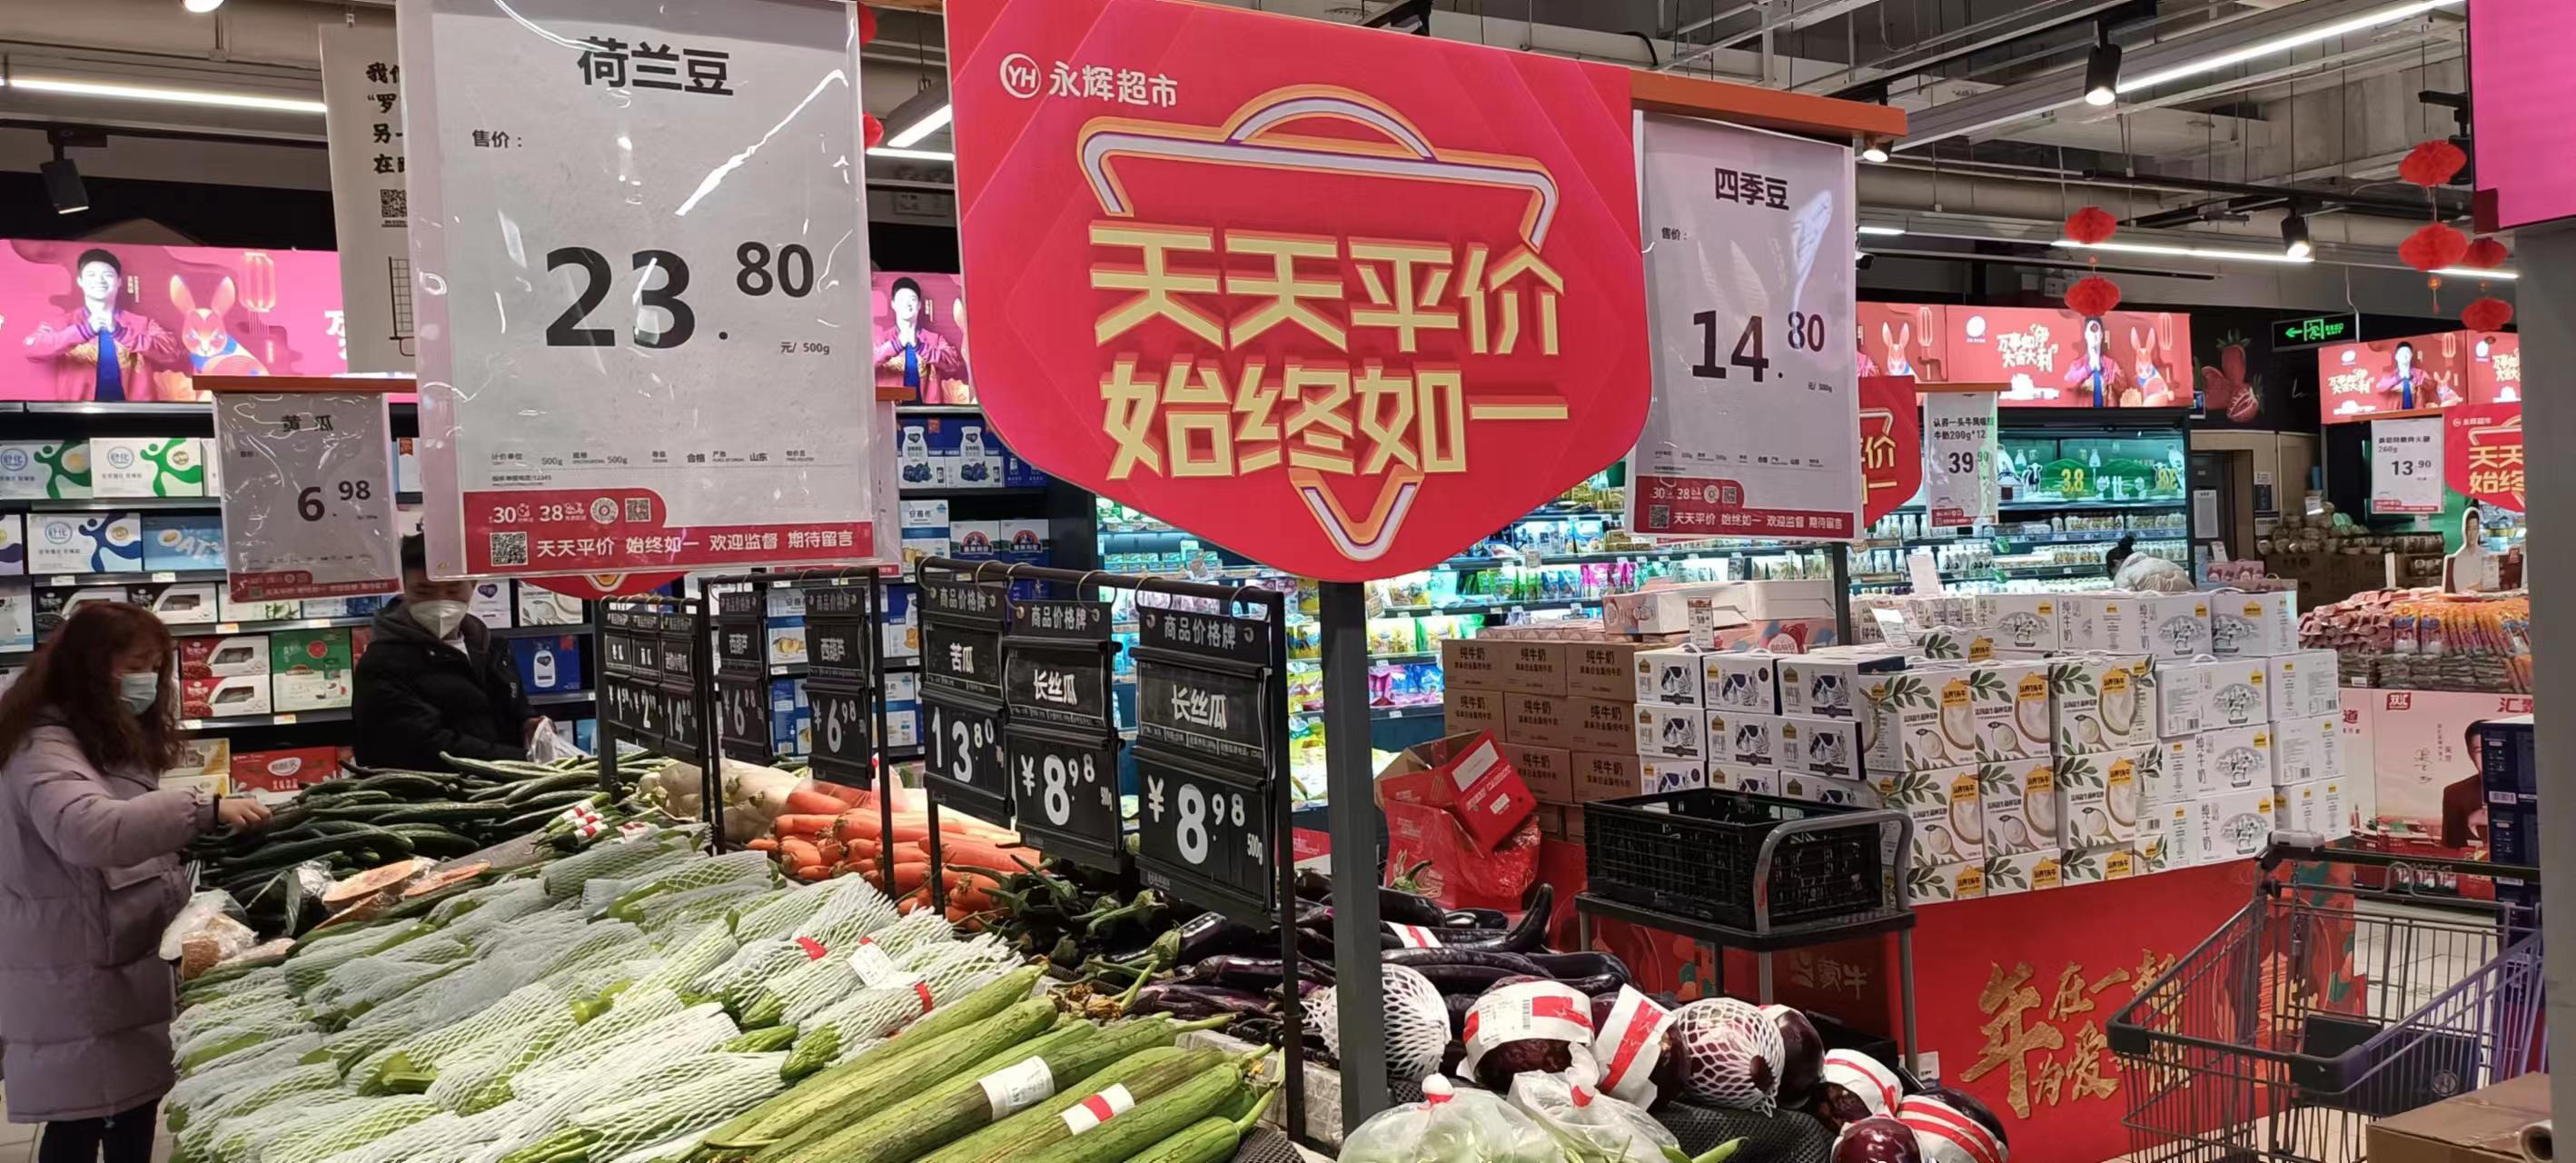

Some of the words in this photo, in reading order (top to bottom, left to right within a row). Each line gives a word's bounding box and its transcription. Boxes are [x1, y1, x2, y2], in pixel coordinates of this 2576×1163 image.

[577, 35, 733, 96] 荷兰豆
[1048, 60, 1178, 108] 永辉超市
[1715, 167, 1789, 211] 四季豆
[1089, 220, 1565, 355] 天天平价
[803, 342, 830, 355] 500g
[1099, 353, 1569, 481] 始终如一
[541, 457, 563, 466] 500g
[607, 456, 628, 465] 500g
[749, 452, 768, 462] 山东
[1860, 436, 1896, 470] 价
[2062, 468, 2084, 492] 3.8
[1673, 512, 1716, 525] 天天平价
[1721, 513, 1761, 527] 始终如一
[537, 536, 615, 558] 天天平价
[626, 535, 699, 555] 始终如一
[709, 532, 778, 552] 欢迎监督
[788, 530, 854, 550] 期待留言
[940, 586, 986, 611] 商品价格牌
[1031, 603, 1087, 631] 商品价格牌
[1164, 613, 1236, 650] 商品价格牌
[949, 641, 975, 674] 苦瓜
[1460, 647, 1485, 661] 纯牛奶
[1521, 647, 1546, 662] 纯牛奶
[1586, 650, 1614, 664] 纯牛奶
[1033, 669, 1077, 705] 长丝瓜
[1171, 683, 1227, 731] 长丝瓜
[1461, 696, 1485, 710] 纯牛奶
[1524, 700, 1551, 715] 纯牛奶
[1590, 704, 1623, 721] 纯牛奶
[1592, 759, 1623, 776] 纯牛奶
[1100, 787, 1113, 811] 500g
[1247, 833, 1263, 865] 500g
